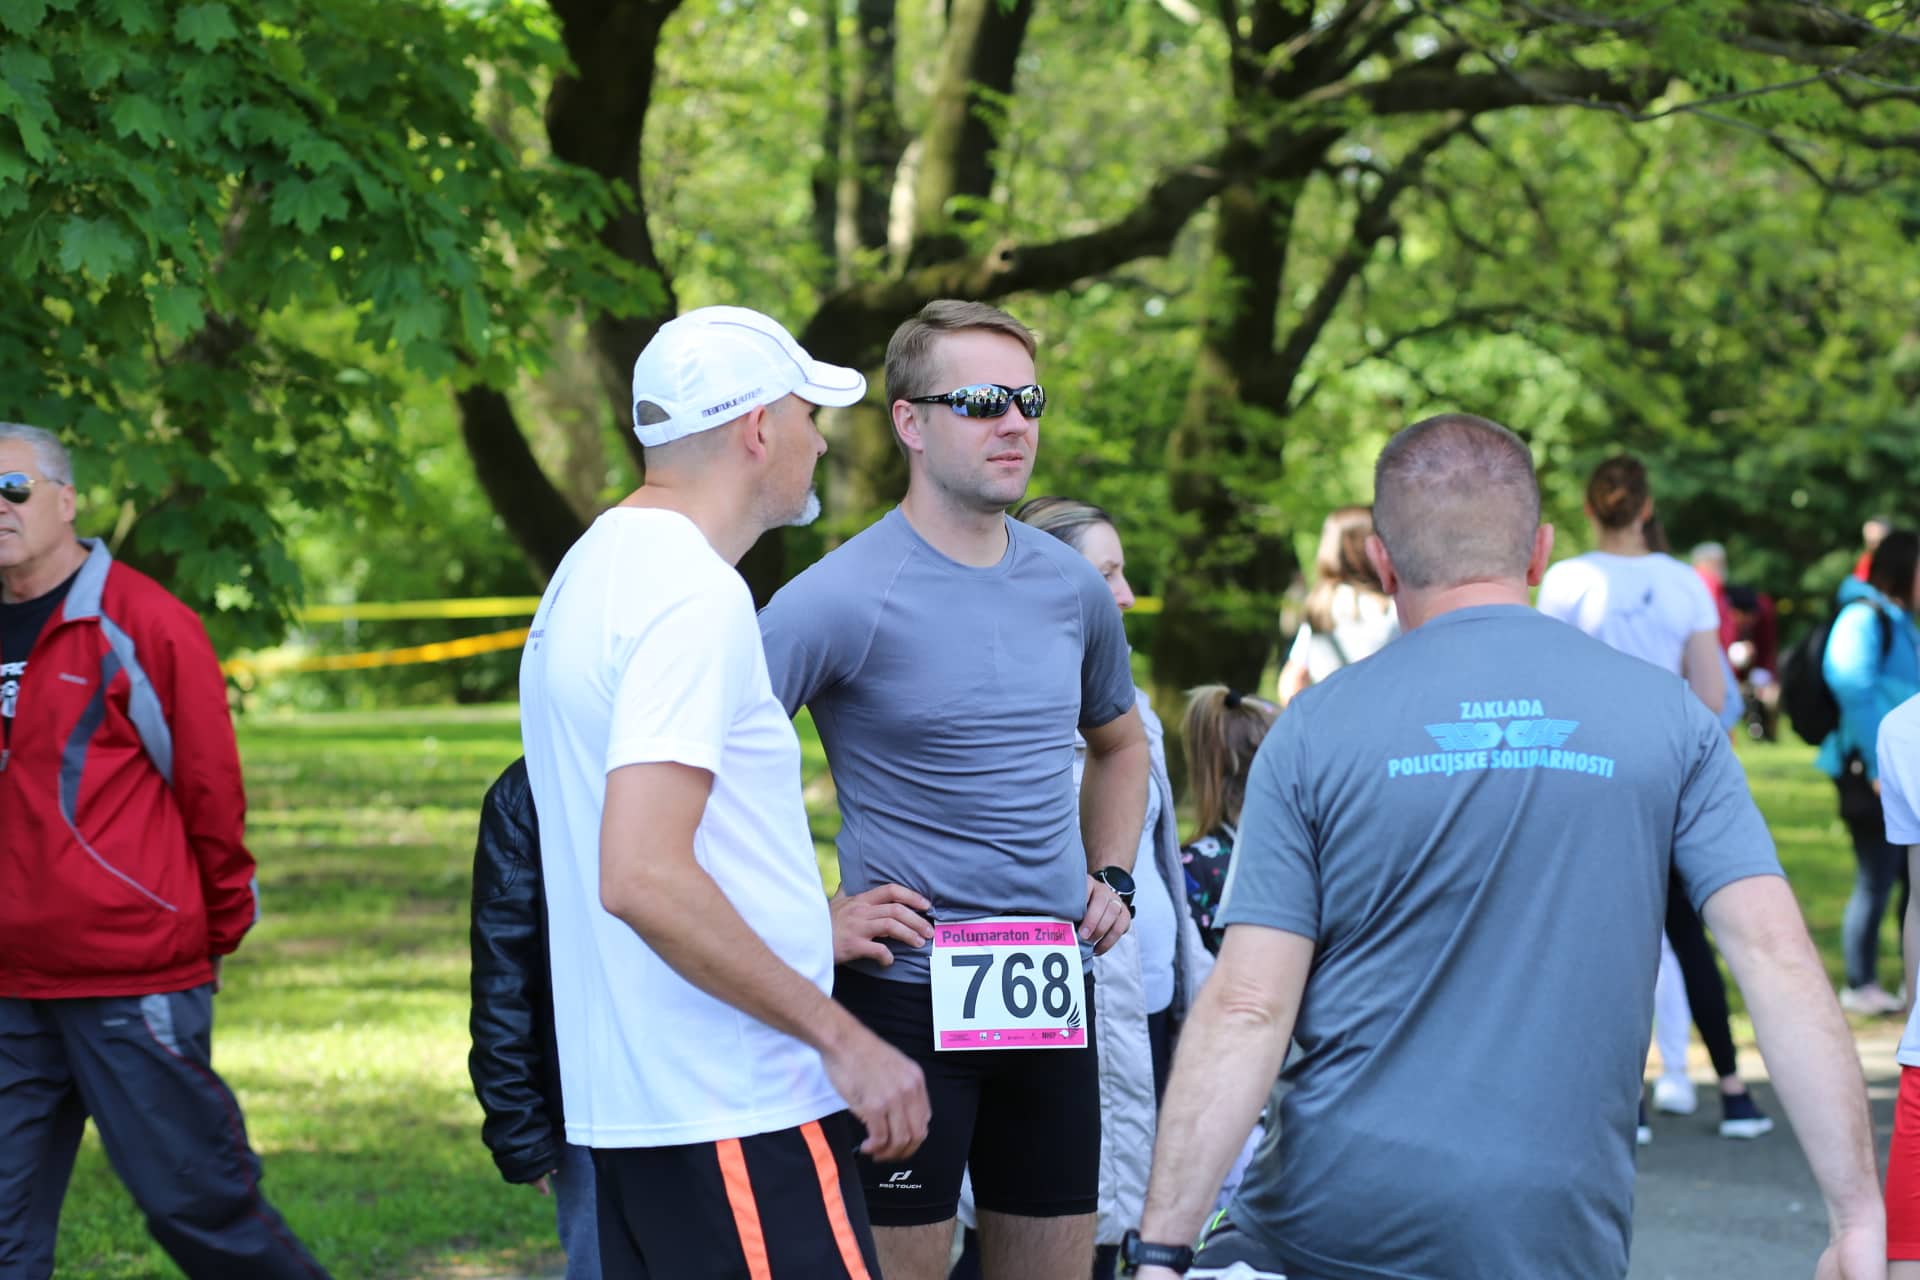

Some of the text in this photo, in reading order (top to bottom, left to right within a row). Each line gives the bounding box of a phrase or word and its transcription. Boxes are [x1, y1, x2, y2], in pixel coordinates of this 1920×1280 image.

[1460, 699, 1544, 719] ZAKLADA
[1388, 749, 1615, 778] POLICIJSKE SOLIDARNOSTI
[942, 929, 1030, 944] Polumaraton
[951, 952, 1072, 1020] 768
